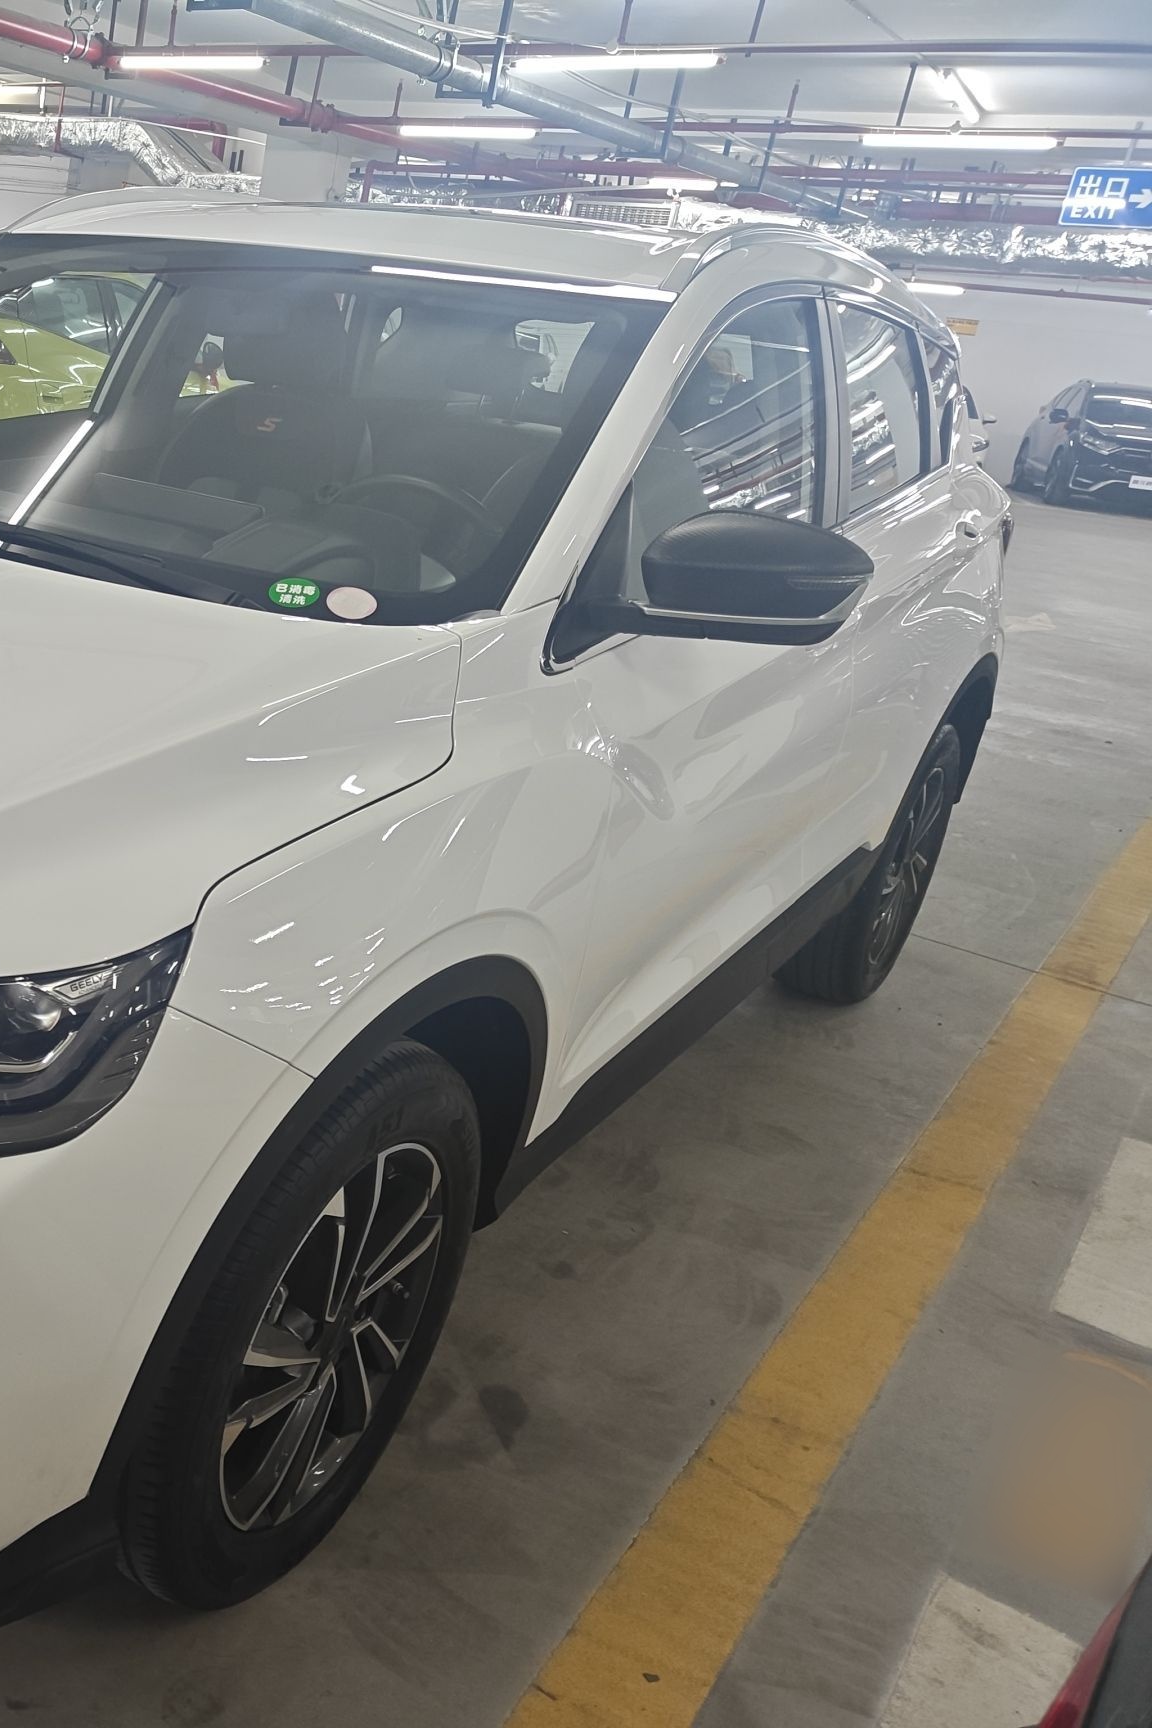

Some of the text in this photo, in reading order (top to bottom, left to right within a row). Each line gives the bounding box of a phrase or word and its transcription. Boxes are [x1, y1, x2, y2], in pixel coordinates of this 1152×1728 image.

[1074, 174, 1130, 200] 出口
[1069, 204, 1120, 220] EXIT
[69, 974, 105, 993] GEELY
